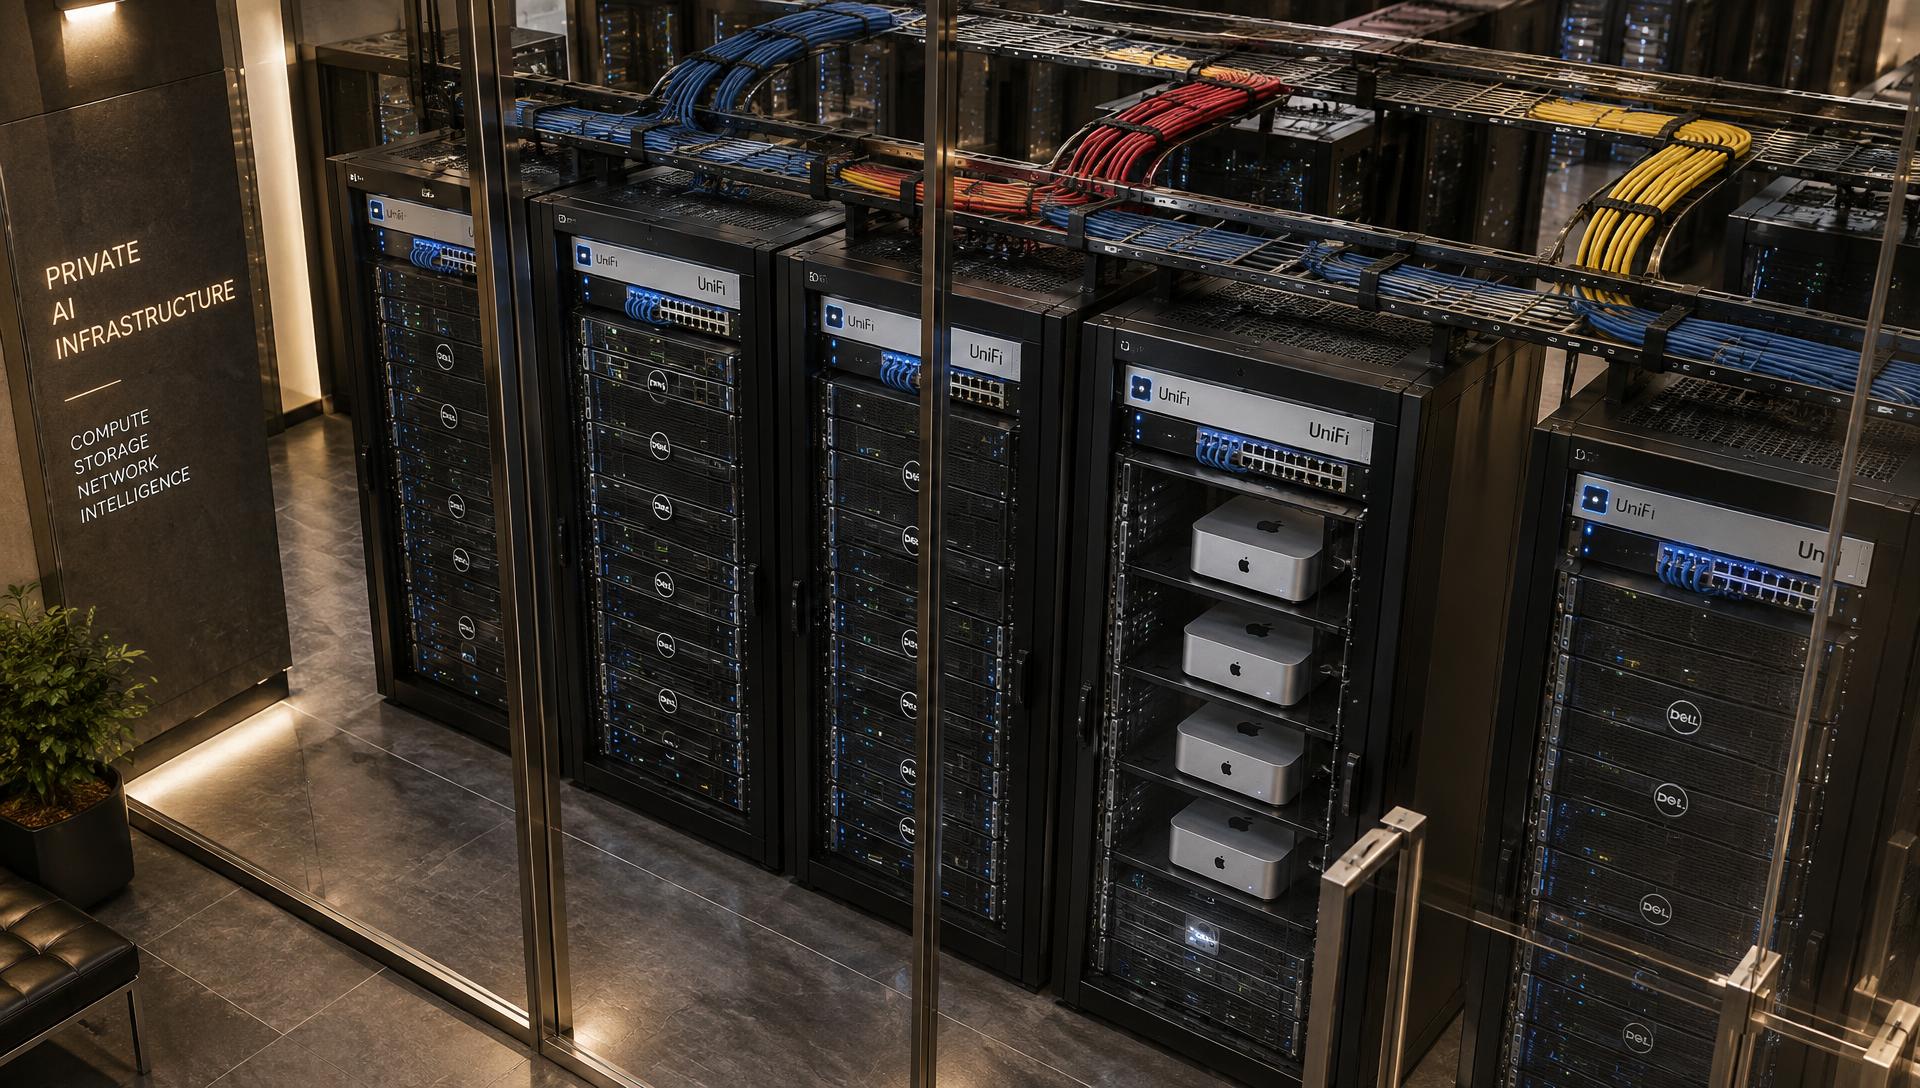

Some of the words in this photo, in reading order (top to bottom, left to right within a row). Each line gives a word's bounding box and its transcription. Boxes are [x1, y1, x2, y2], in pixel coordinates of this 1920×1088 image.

[45, 240, 141, 290] PRIVATE
[596, 253, 618, 268] UniFi
[697, 275, 726, 296] UniFi
[52, 297, 76, 326] AI
[55, 279, 236, 360] INFRASTRUCTURE
[848, 315, 875, 332] UniFi
[969, 343, 1004, 366] UniFi
[1158, 385, 1191, 406] UniFi
[70, 408, 150, 451] COMPUTE
[1309, 421, 1351, 445] UniFi
[74, 433, 150, 475] STORAGE
[77, 454, 160, 500] NETWORK
[80, 465, 191, 524] INTELLIGENCE
[1615, 497, 1657, 521] UniFi
